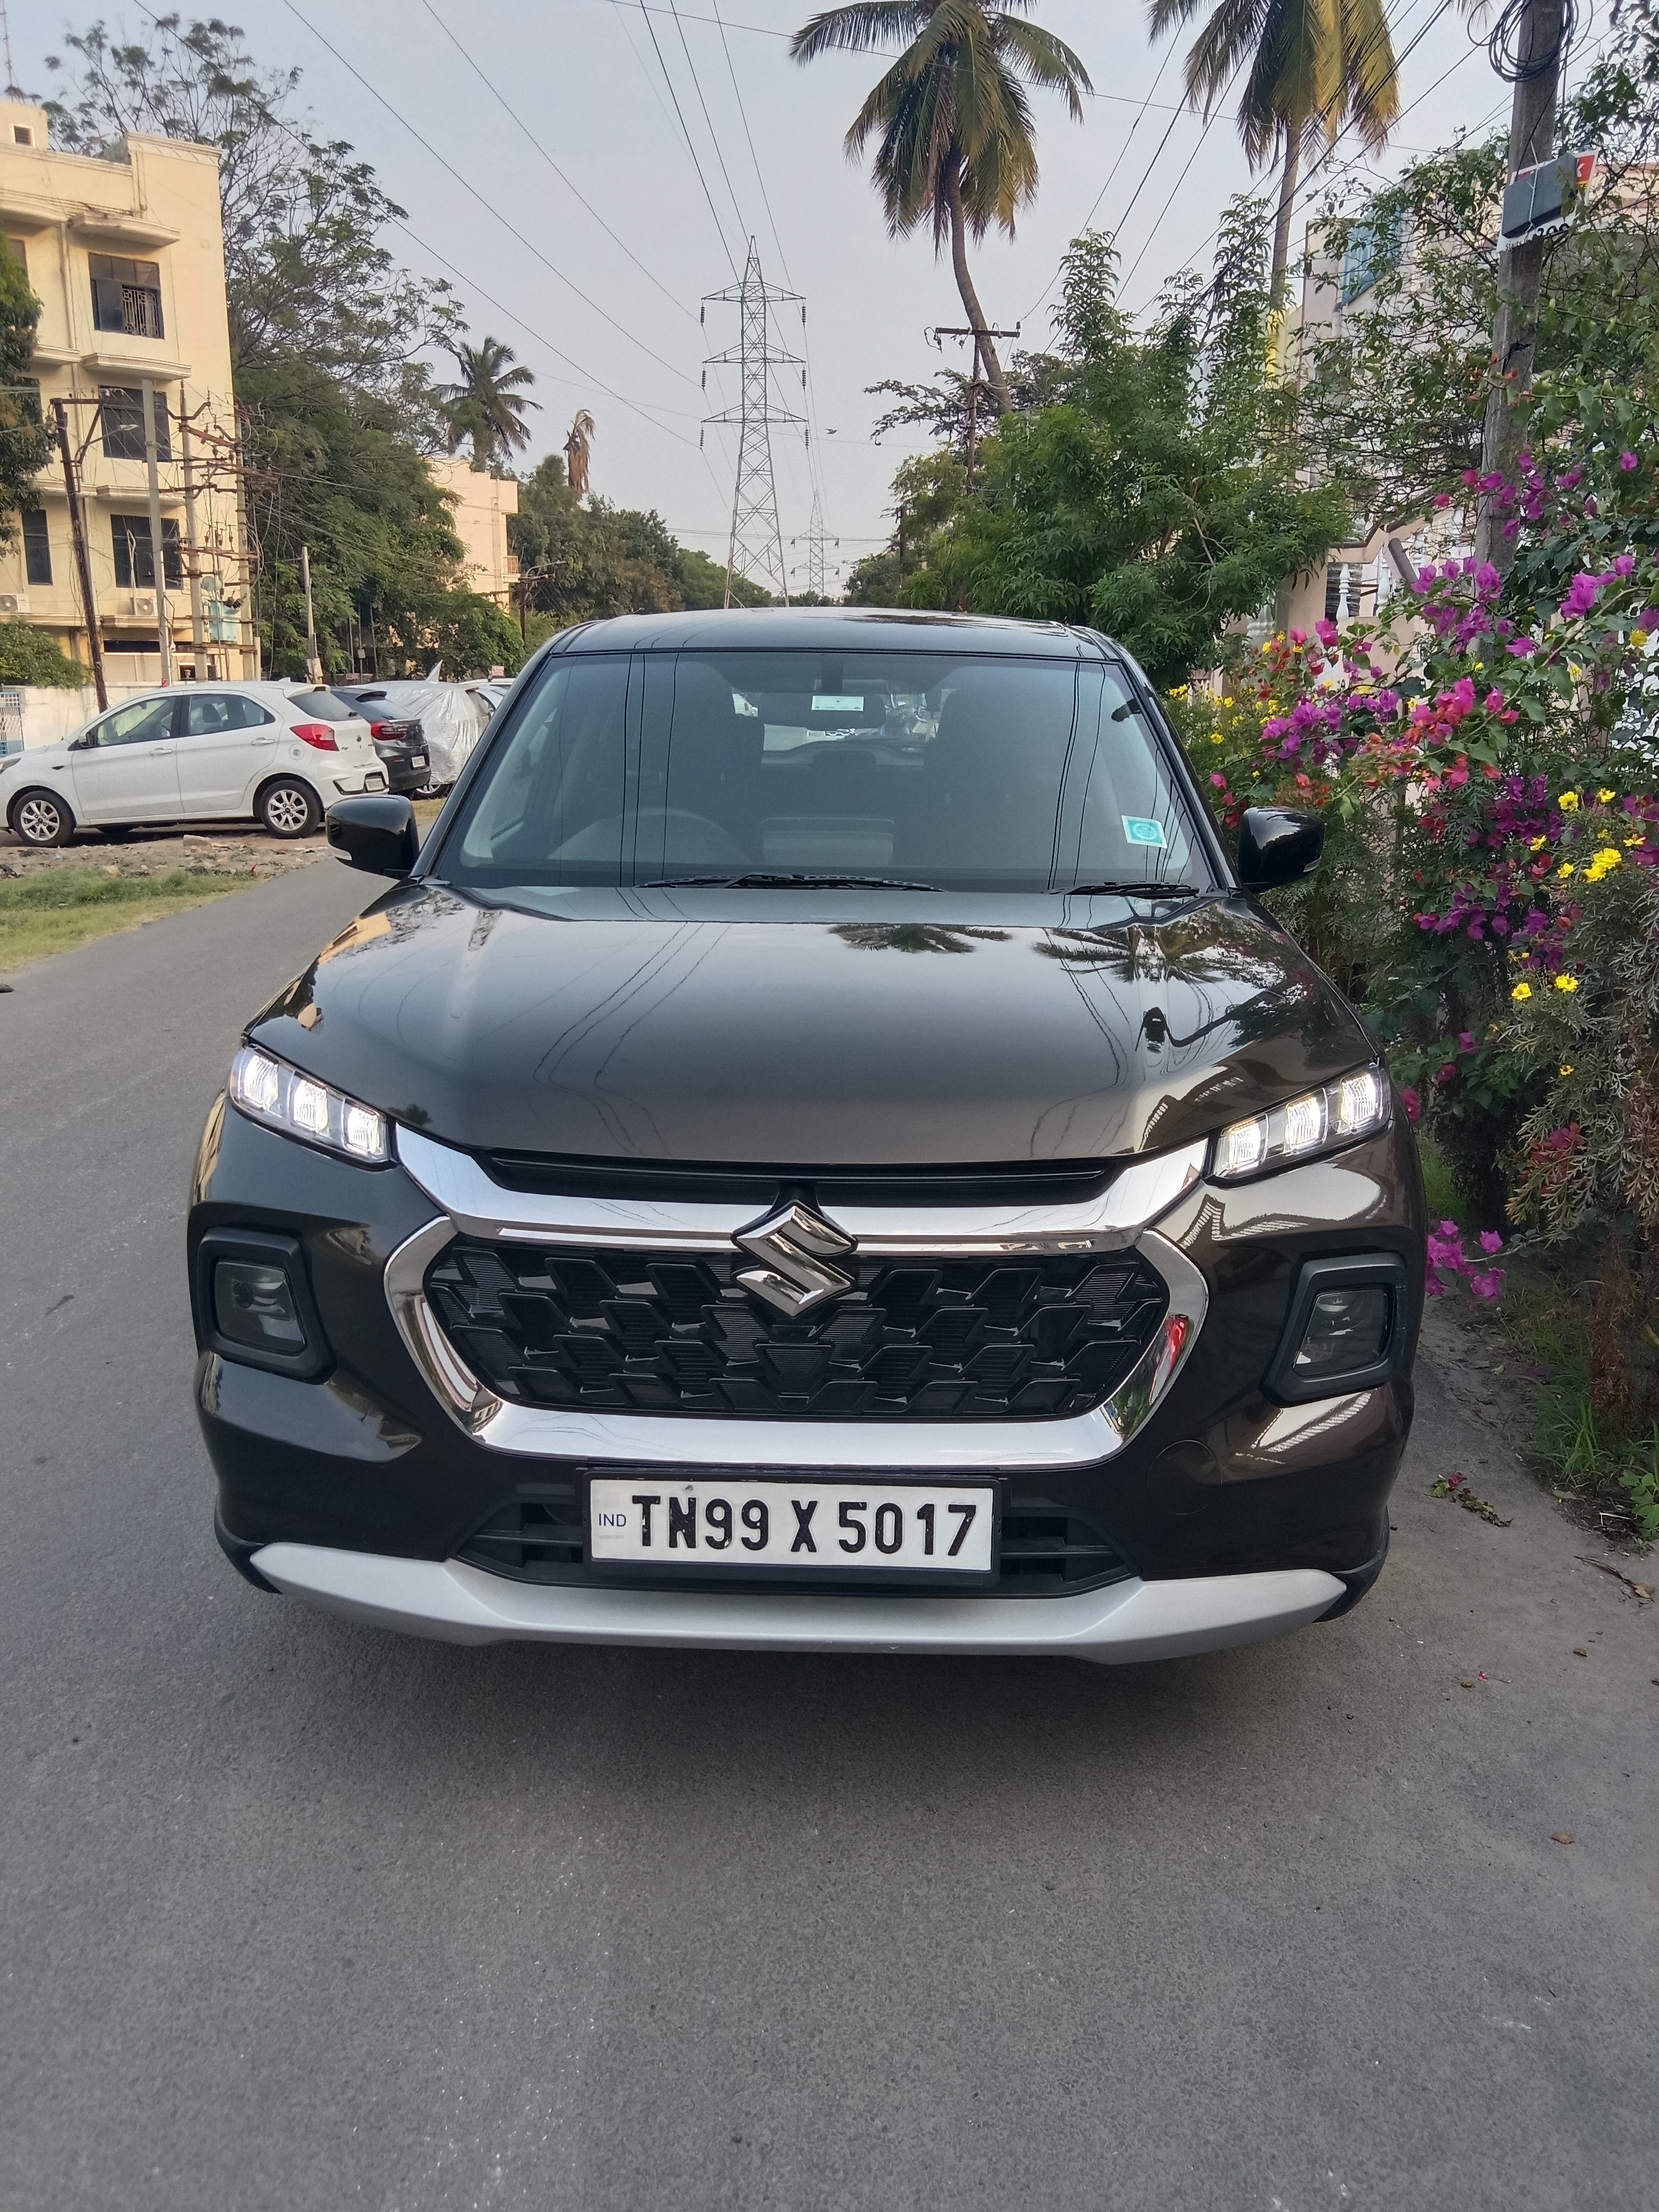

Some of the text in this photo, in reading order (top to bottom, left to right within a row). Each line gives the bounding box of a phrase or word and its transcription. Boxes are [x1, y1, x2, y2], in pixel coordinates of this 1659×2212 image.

[599, 1513, 626, 1527] IND
[632, 1495, 977, 1556] TN99 X 5017
